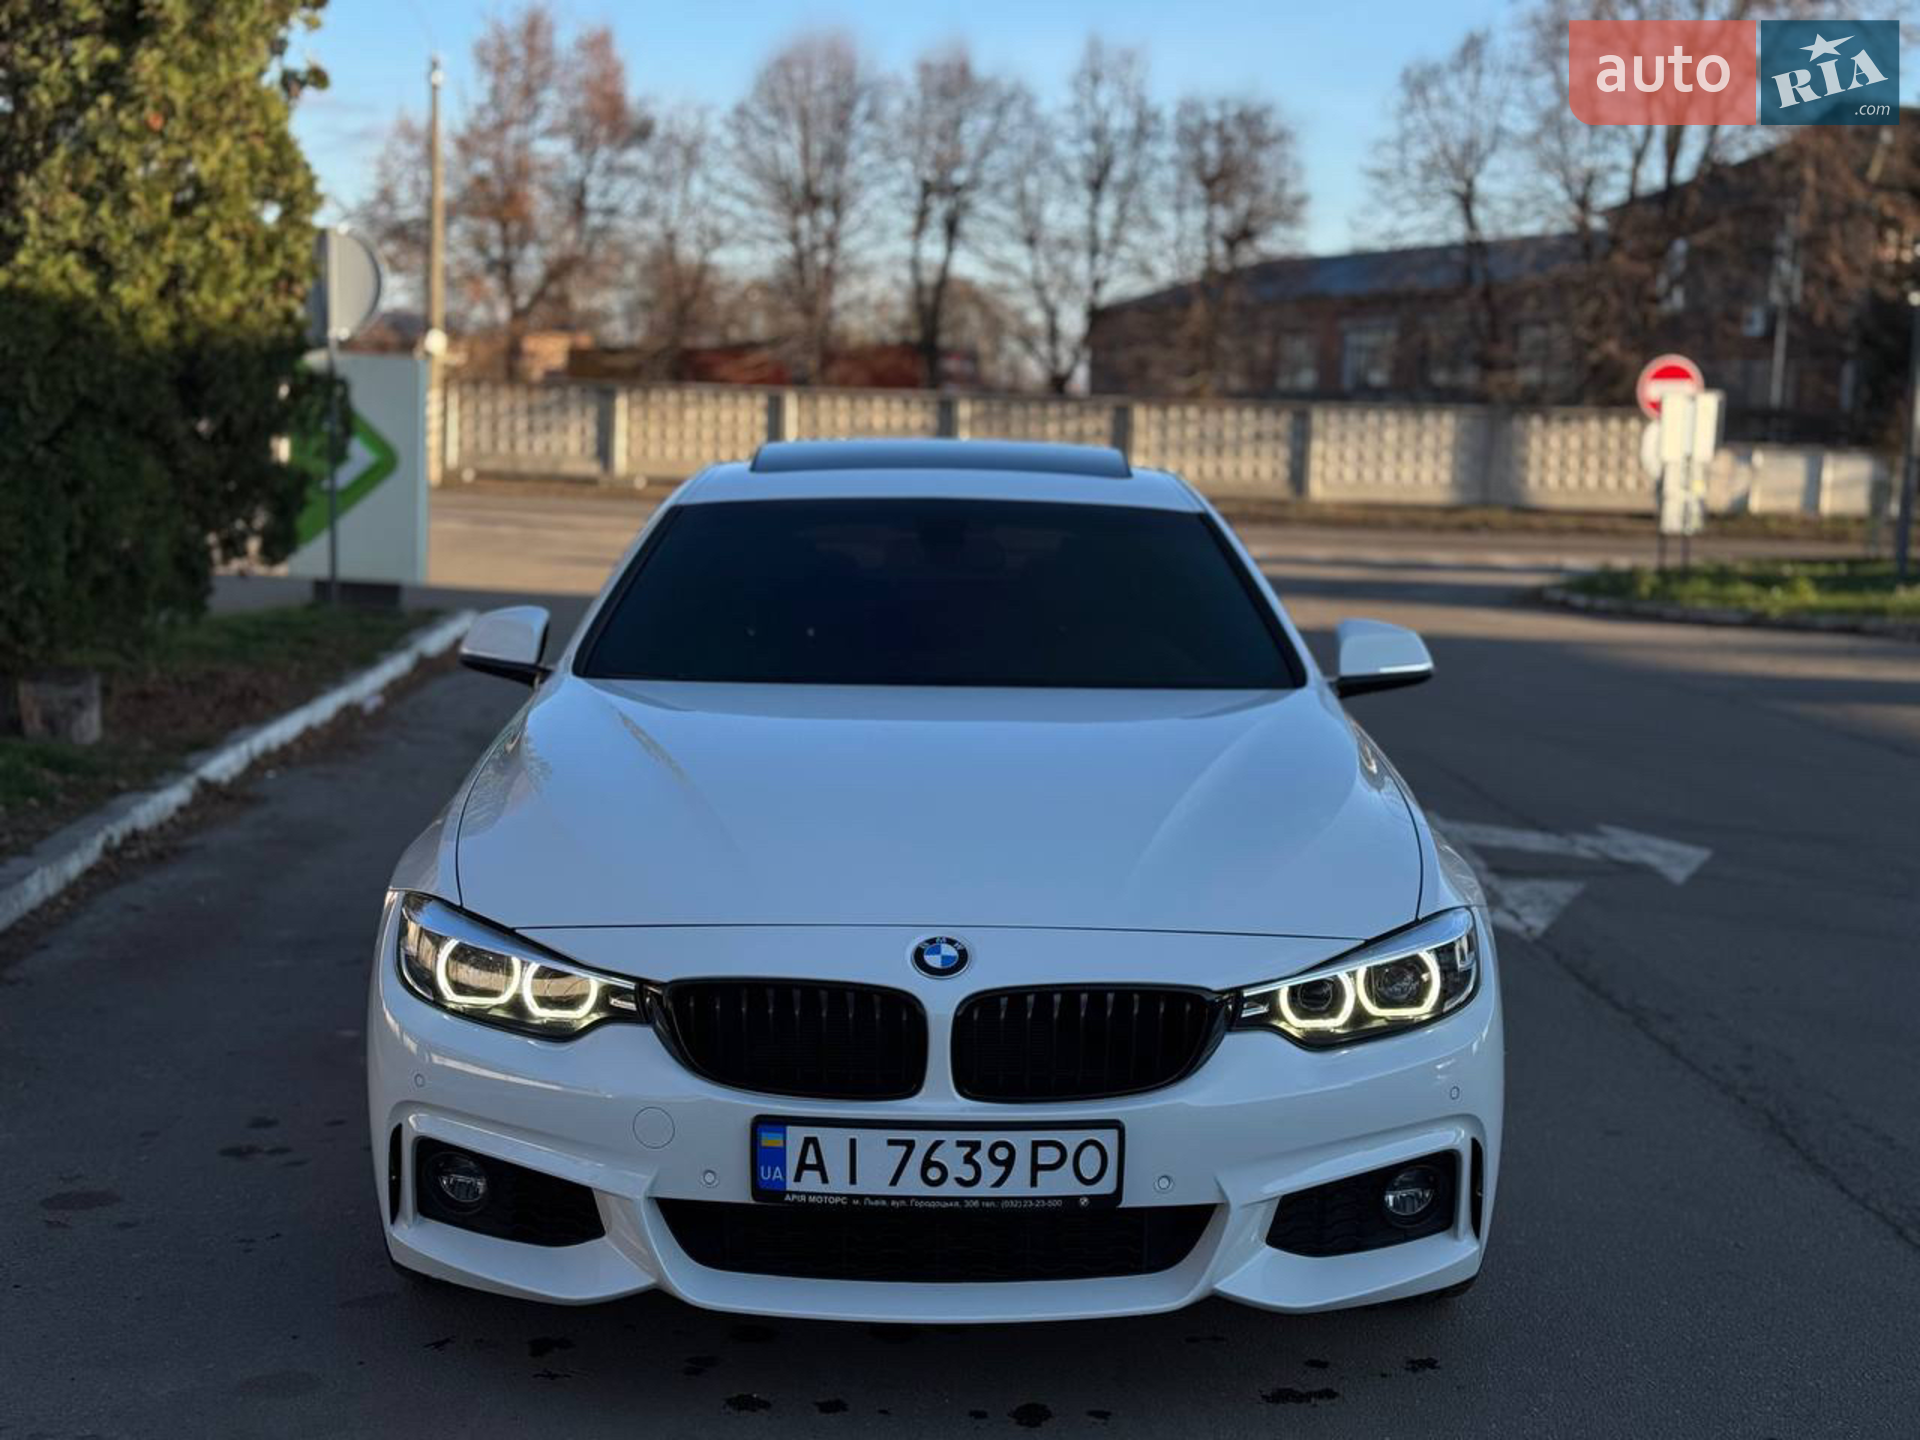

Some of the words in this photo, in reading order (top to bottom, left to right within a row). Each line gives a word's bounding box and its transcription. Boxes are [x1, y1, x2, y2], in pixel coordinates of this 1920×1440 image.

[886, 1138, 1017, 1188] 7639
[1029, 1138, 1109, 1188] PO
[759, 1165, 784, 1182] UA
[807, 1194, 849, 1206] МОТОРС
